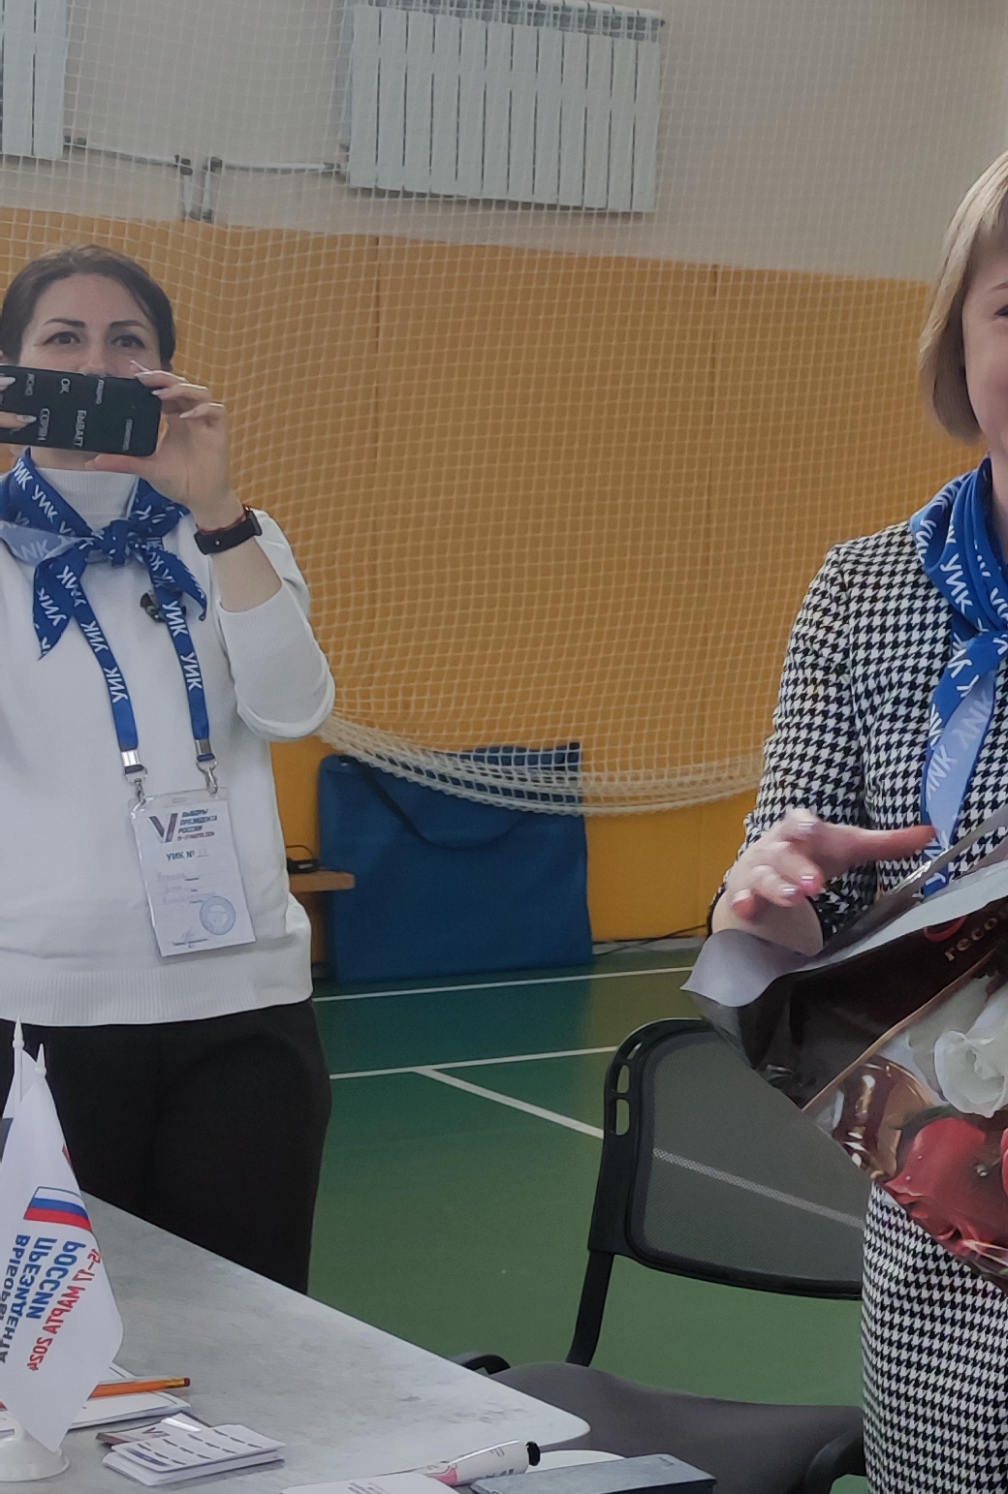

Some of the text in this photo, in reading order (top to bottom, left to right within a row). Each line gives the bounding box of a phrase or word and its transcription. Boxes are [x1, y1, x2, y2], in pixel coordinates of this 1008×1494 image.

[32, 484, 58, 525] УИК
[940, 553, 973, 614] УИК
[36, 587, 67, 627] УИК
[162, 600, 189, 637] УИК
[80, 620, 109, 653] УИК
[103, 666, 128, 703] УИК
[180, 652, 202, 691] УИК
